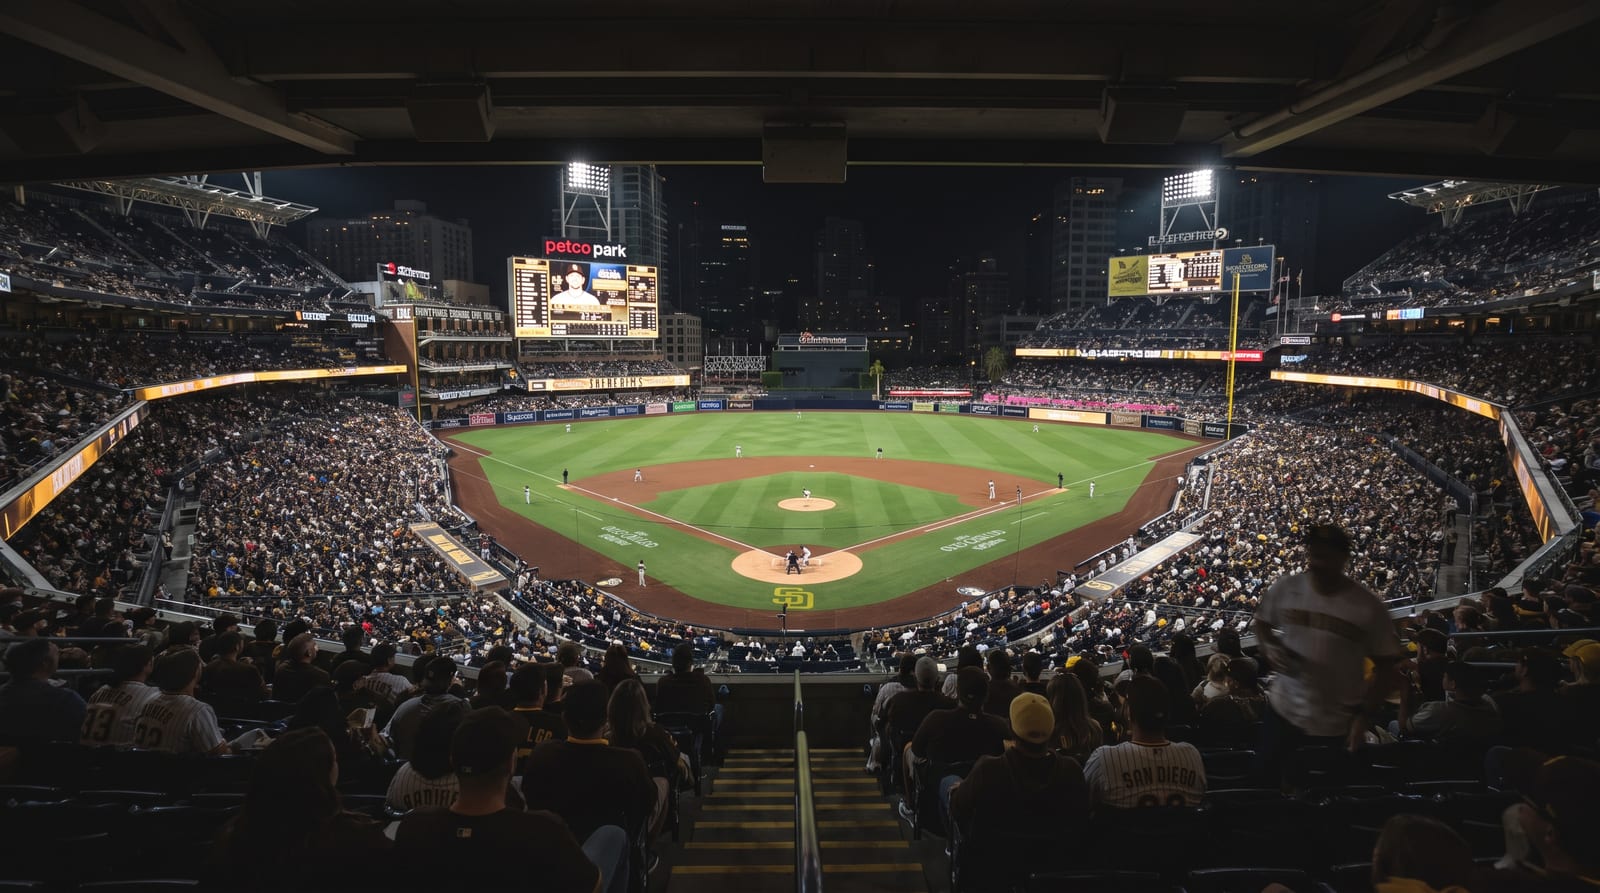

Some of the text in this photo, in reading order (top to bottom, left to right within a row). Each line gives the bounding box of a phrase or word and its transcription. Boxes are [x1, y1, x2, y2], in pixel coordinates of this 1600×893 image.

[545, 239, 627, 259] petco park
[772, 587, 814, 609] SD
[1122, 766, 1197, 788] SAN DIEGO
